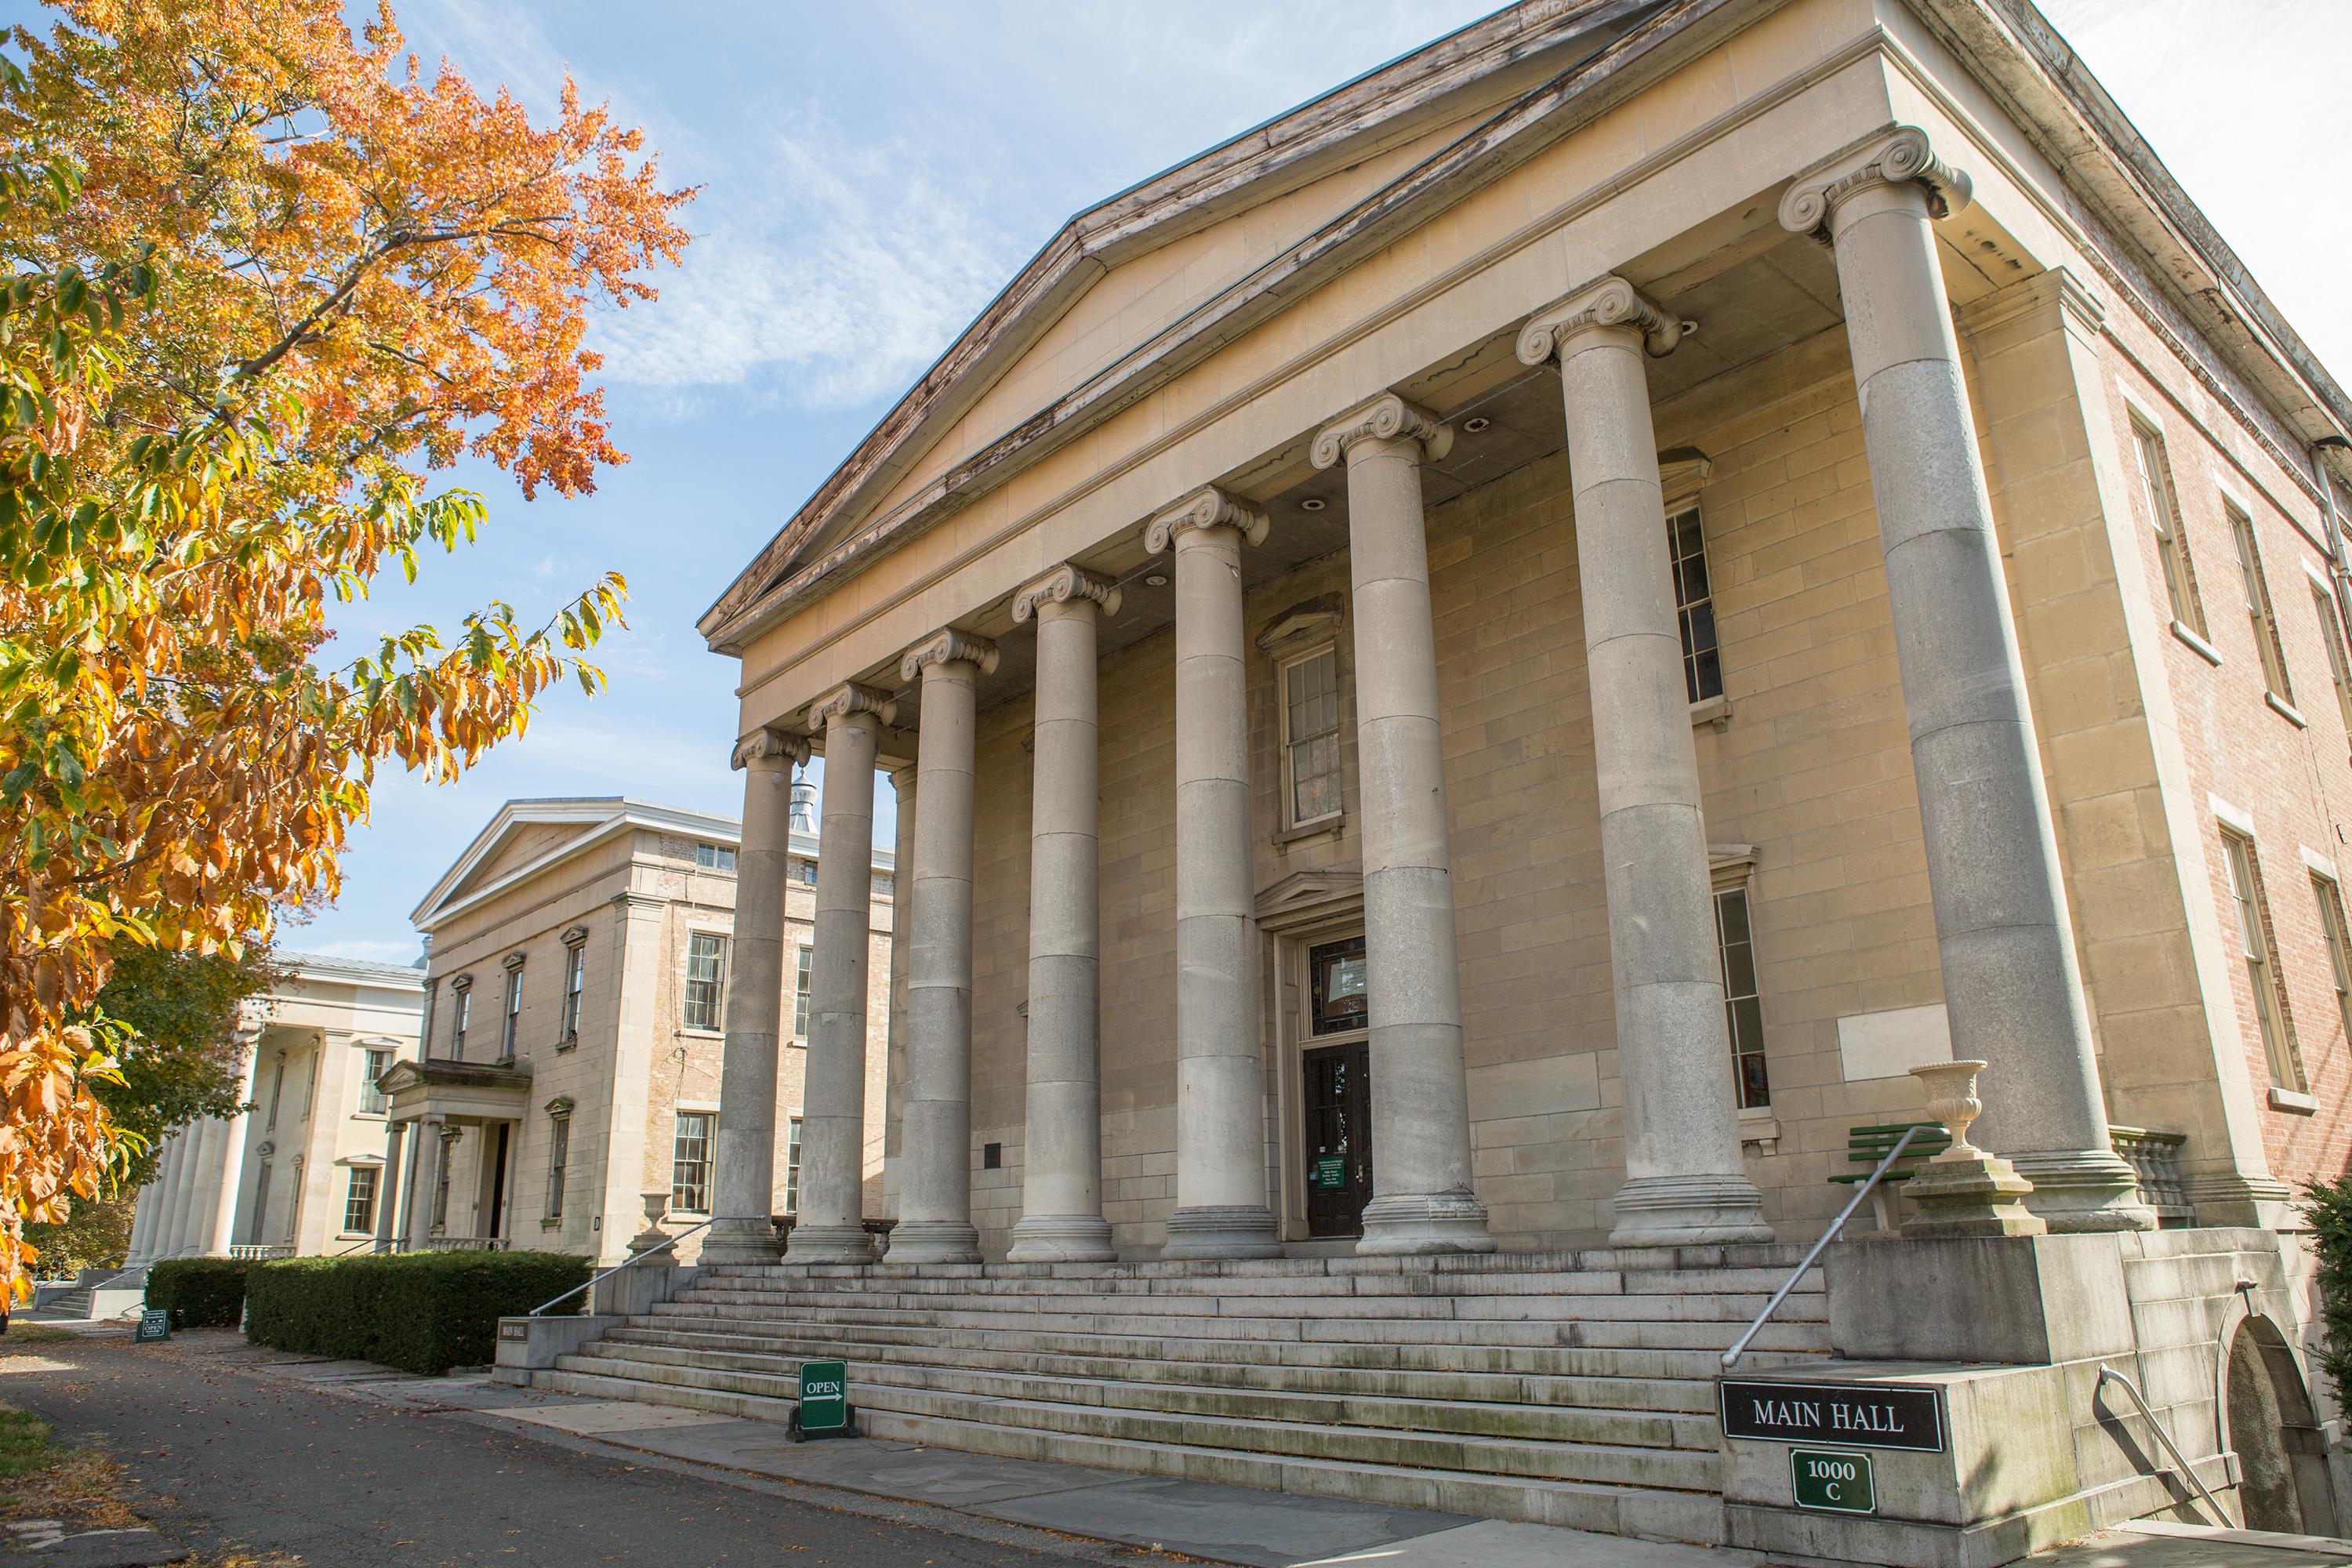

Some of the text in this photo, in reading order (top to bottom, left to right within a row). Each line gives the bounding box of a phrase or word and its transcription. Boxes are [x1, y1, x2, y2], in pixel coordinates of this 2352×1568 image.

[806, 1381, 840, 1394] OPEN
[1752, 1399, 1904, 1433] MAIN HALL
[1806, 1459, 1856, 1481] 1000
[1825, 1483, 1841, 1501] C
